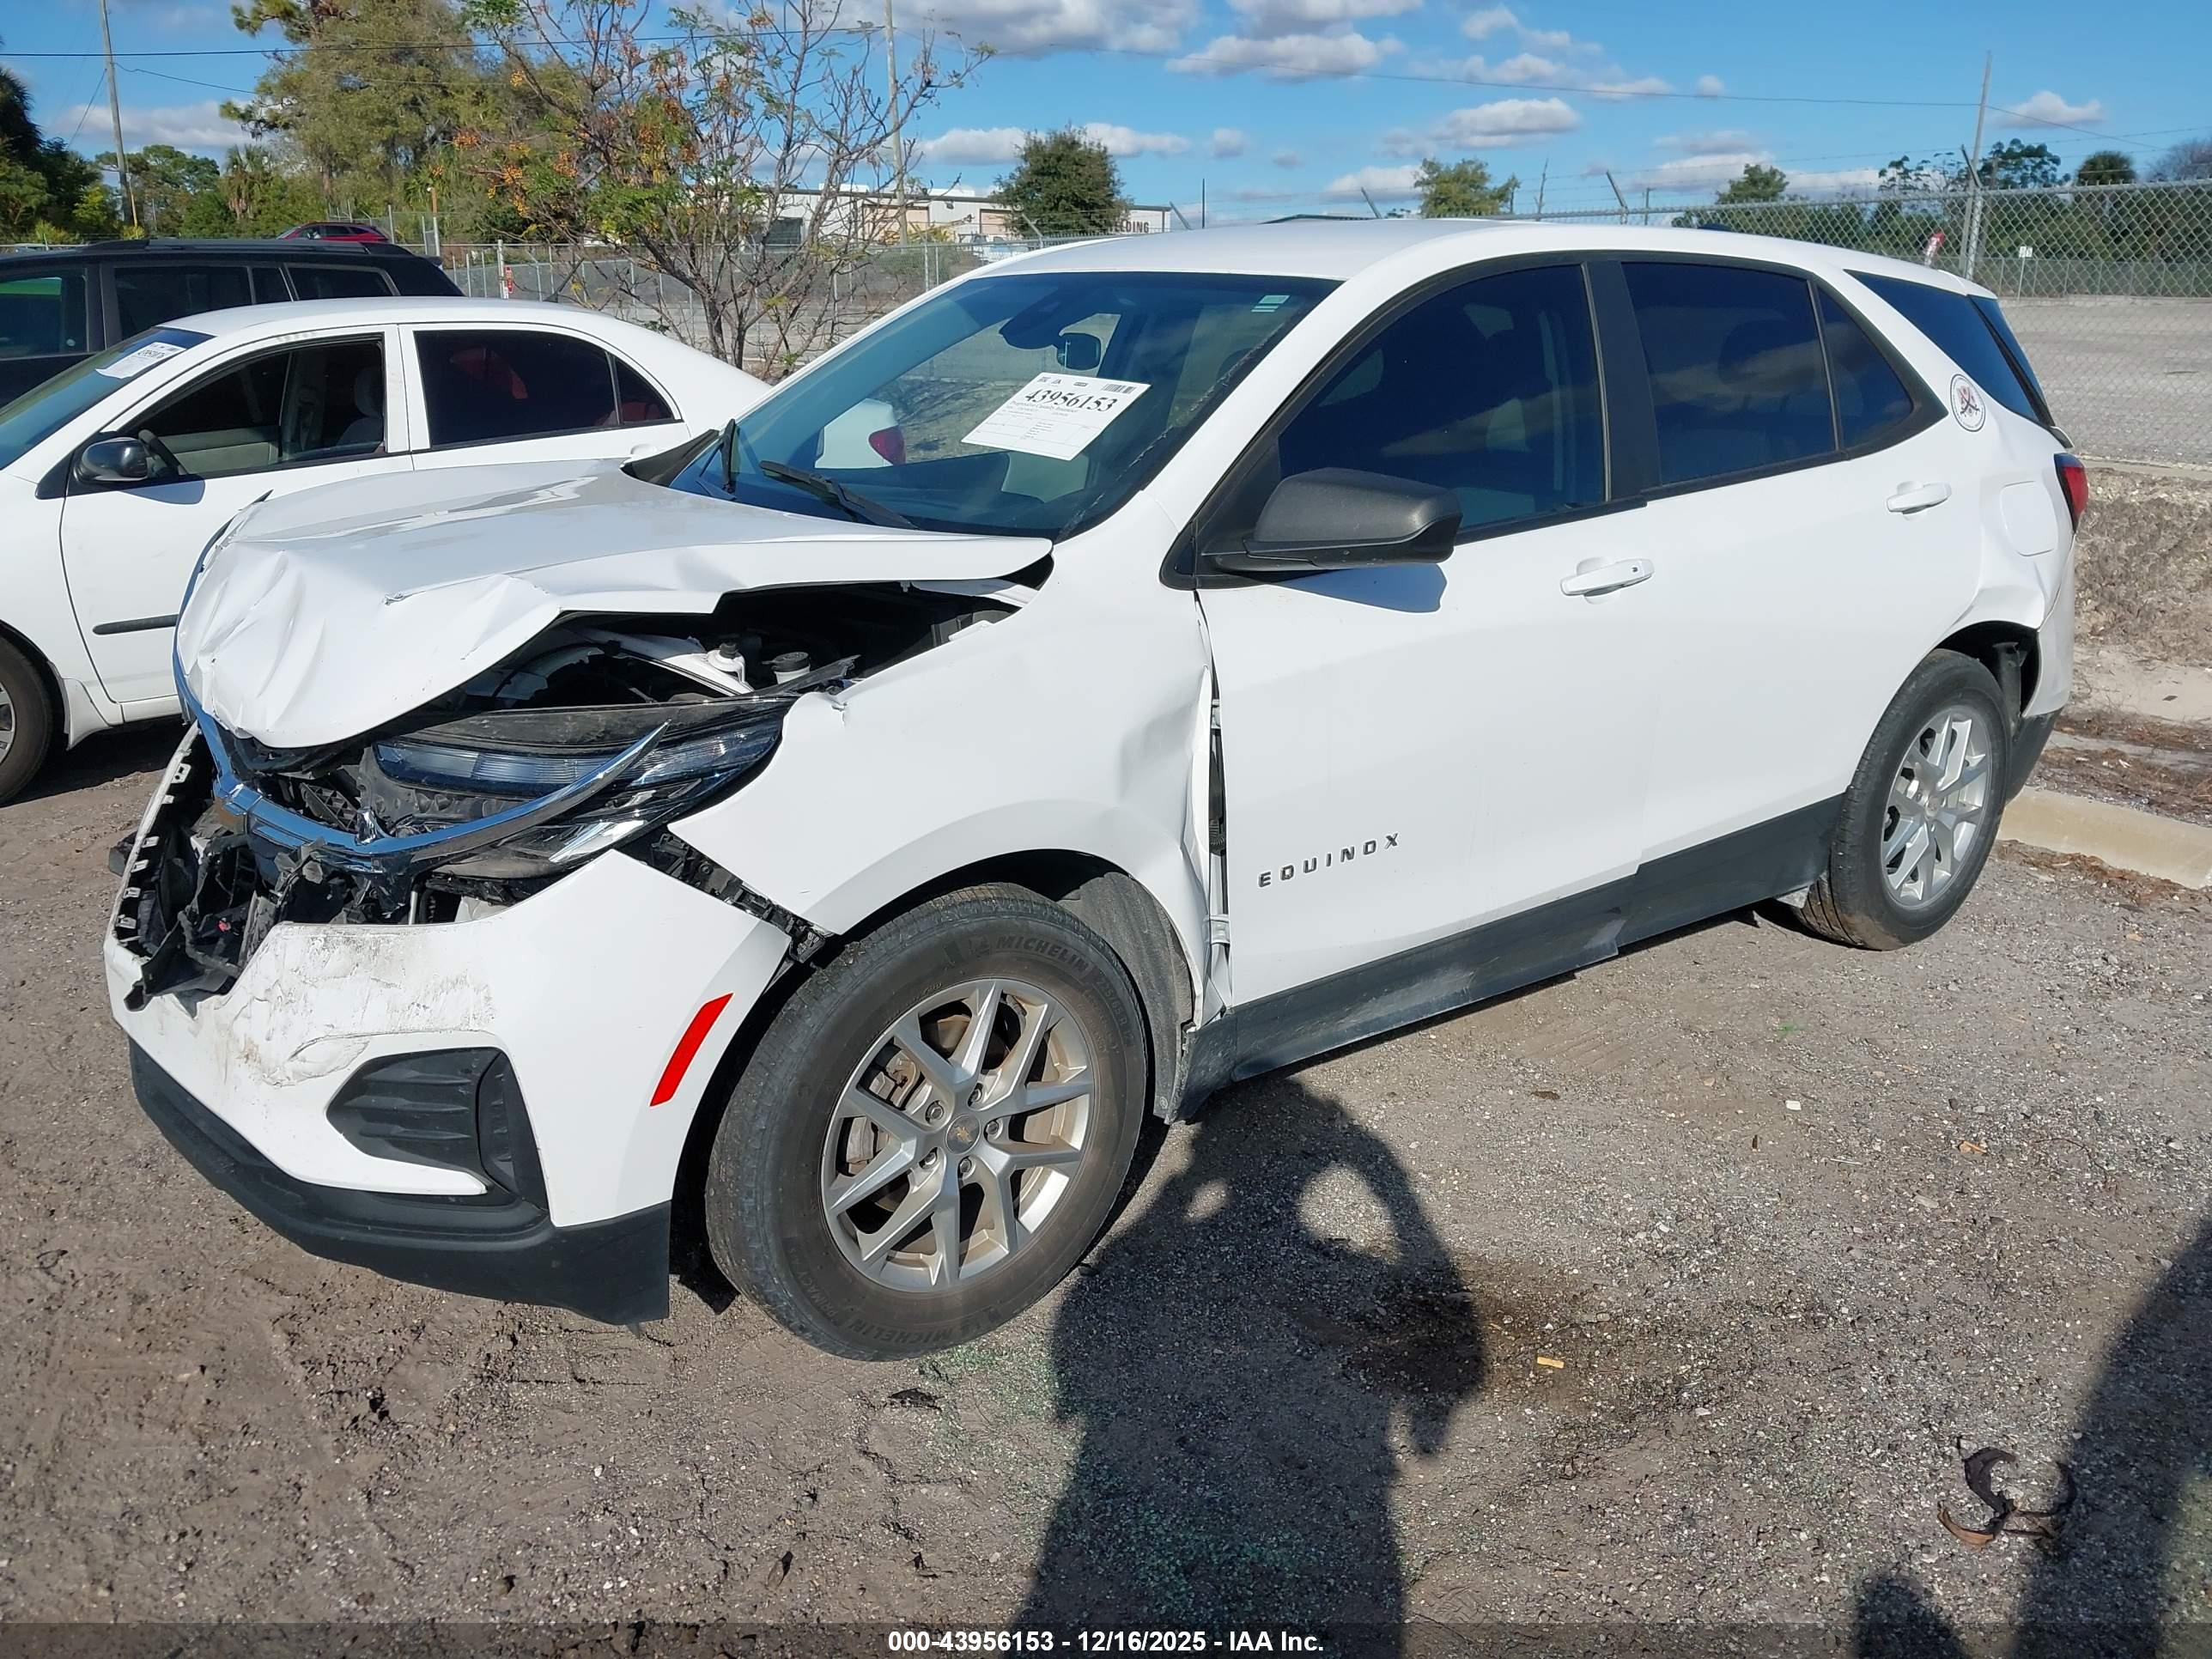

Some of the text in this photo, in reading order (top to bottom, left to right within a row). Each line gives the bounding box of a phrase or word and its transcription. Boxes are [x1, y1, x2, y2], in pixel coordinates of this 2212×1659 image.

[1025, 388, 1118, 412] 43956153
[1258, 832, 1399, 888] EQUINOX
[996, 935, 1091, 975] MICHELIN
[797, 1271, 839, 1317] PRIMACY
[847, 1318, 953, 1345] MICHELIN
